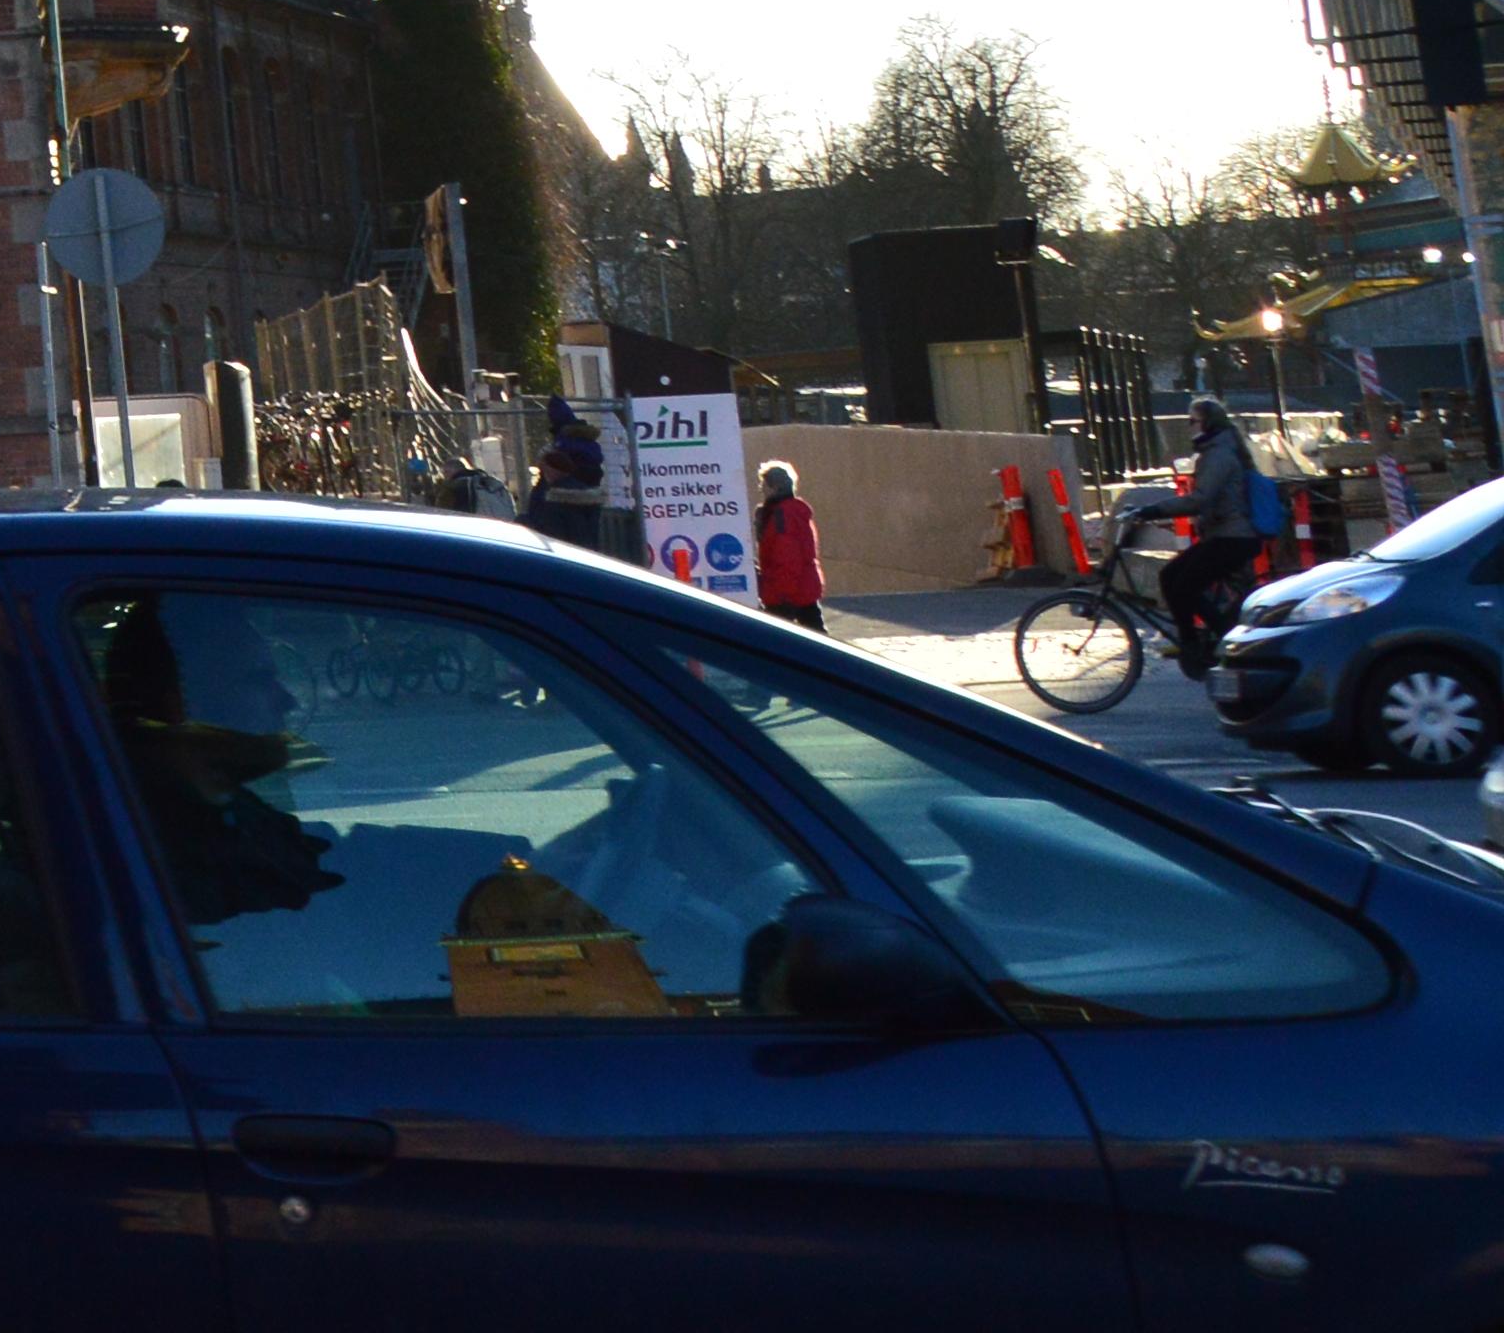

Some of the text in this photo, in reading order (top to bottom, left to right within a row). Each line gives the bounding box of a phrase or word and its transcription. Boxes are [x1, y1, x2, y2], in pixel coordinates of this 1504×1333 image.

[644, 486, 666, 498] en
[671, 482, 722, 497] sikker
[642, 501, 739, 519] GGEPLADS
